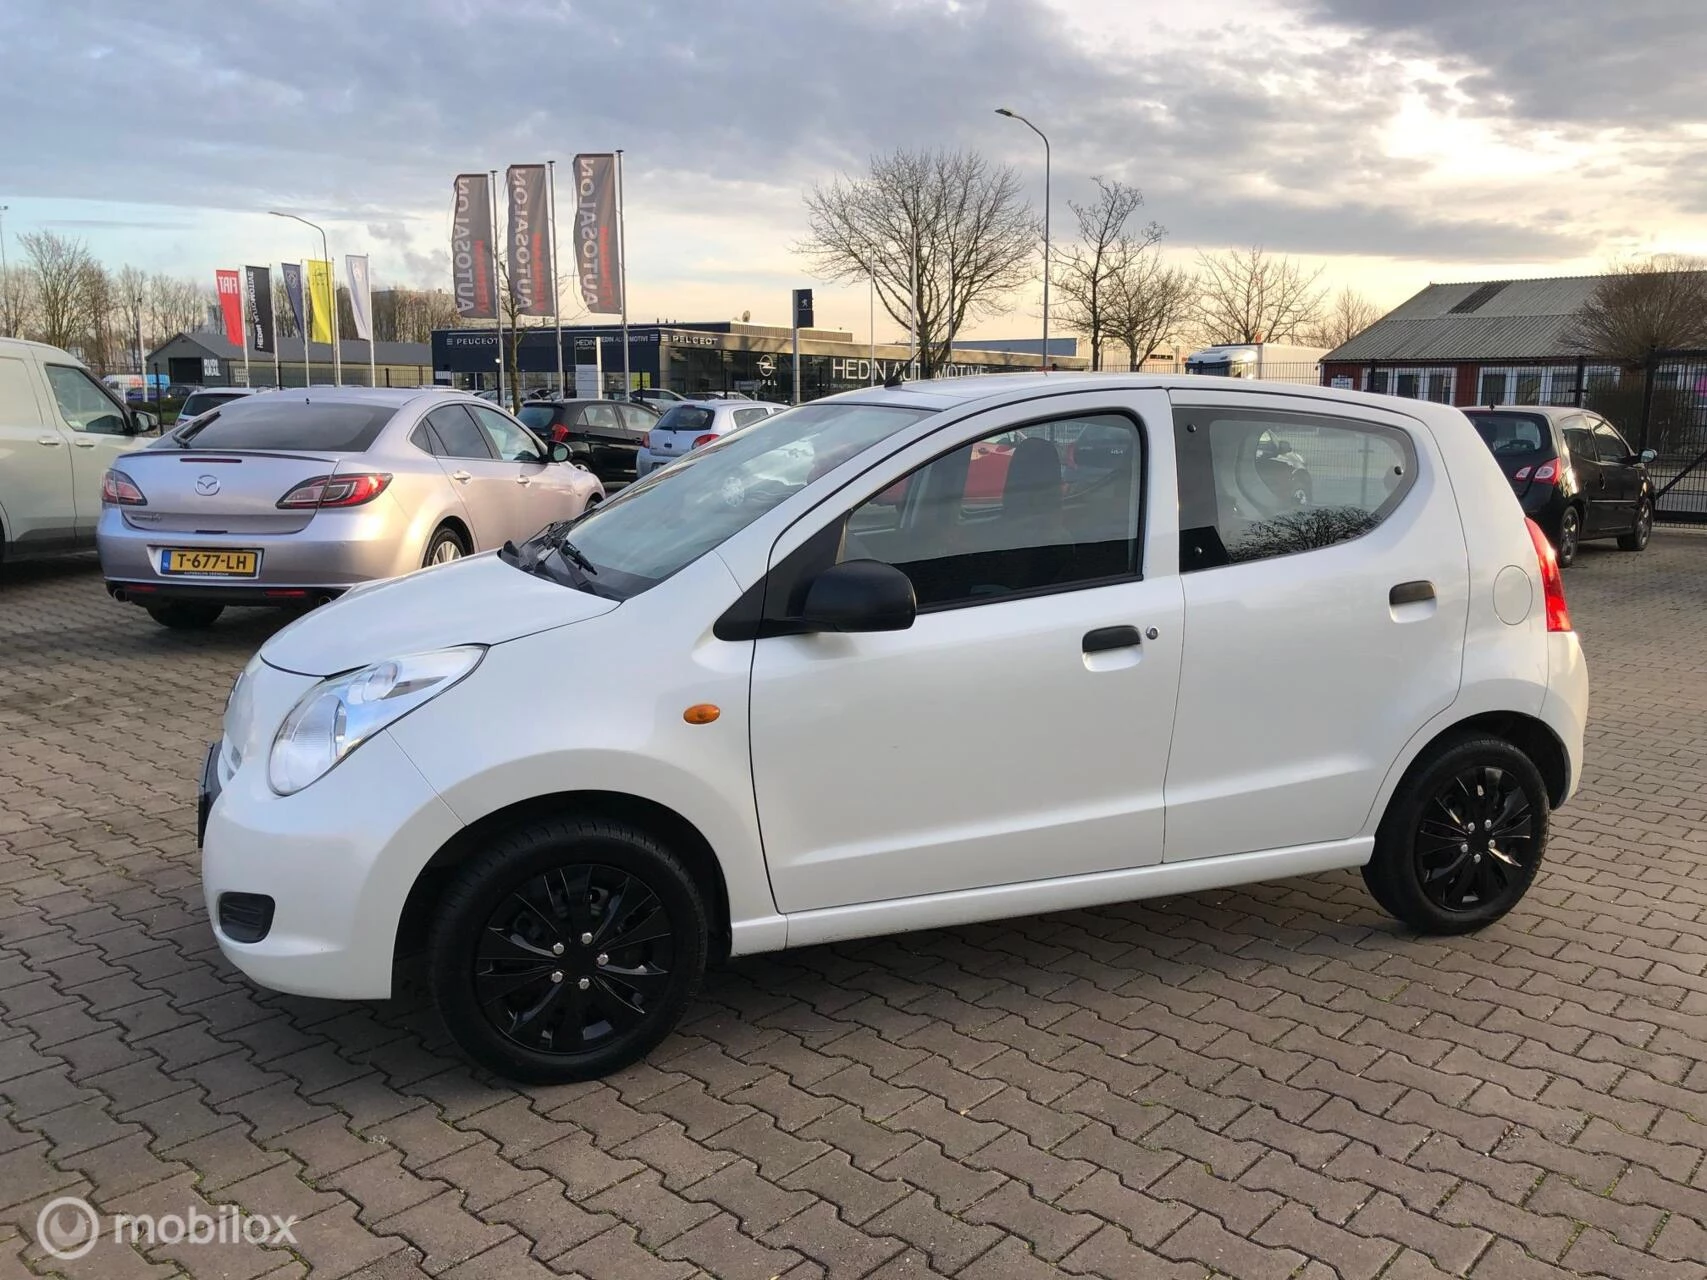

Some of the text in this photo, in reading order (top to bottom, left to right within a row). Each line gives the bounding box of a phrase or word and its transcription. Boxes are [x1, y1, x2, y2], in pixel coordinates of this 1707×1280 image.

[456, 337, 499, 345] PEUGEOT
[832, 358, 988, 381] HEDN AUTMOTIVE
[178, 553, 247, 570] T-677-LH
